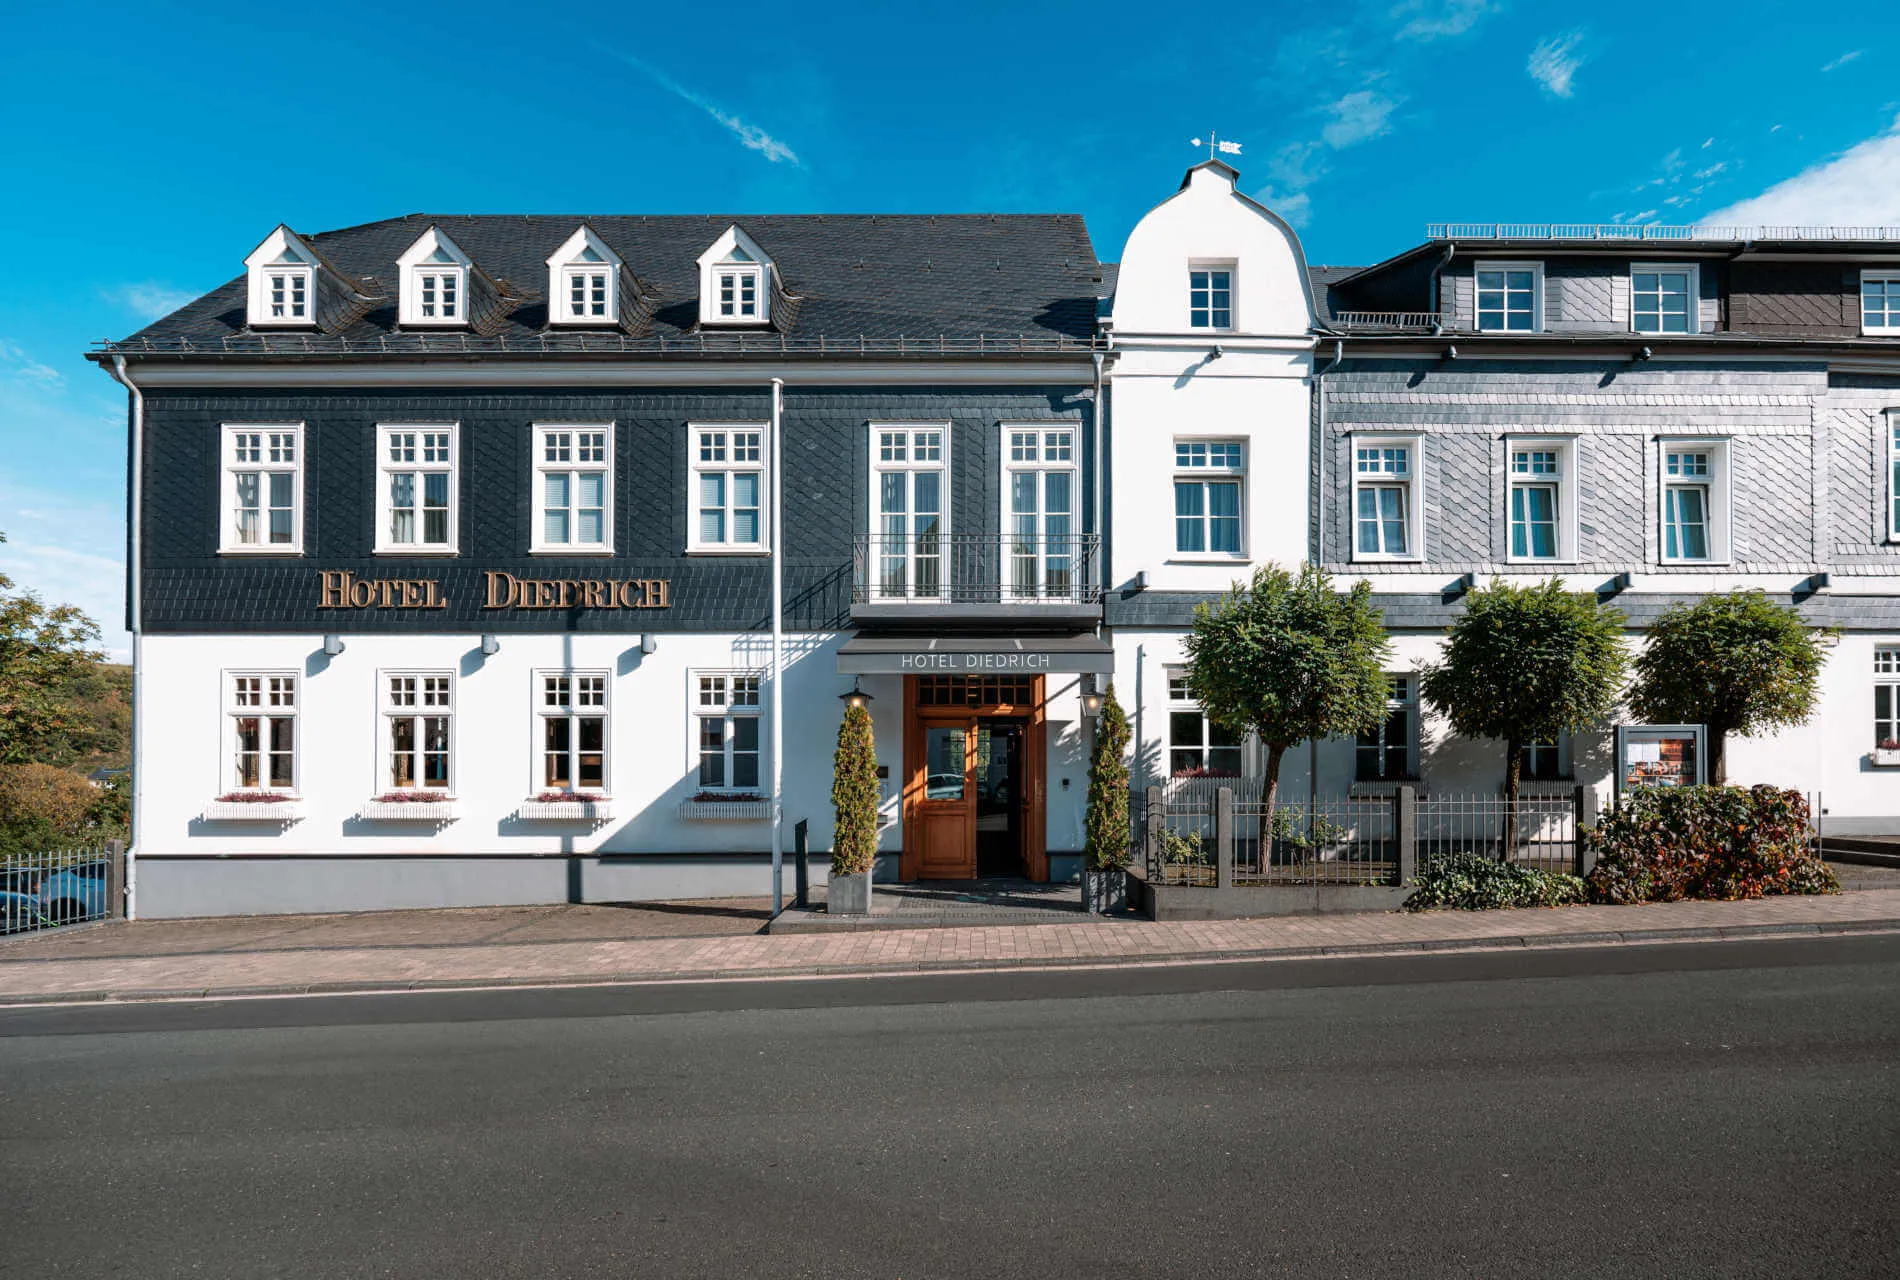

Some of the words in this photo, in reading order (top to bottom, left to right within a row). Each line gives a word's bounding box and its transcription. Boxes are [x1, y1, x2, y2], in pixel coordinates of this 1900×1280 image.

[318, 570, 447, 608] HOTEL
[483, 570, 672, 608] DIEDRICH
[901, 654, 957, 668] HOTEL
[966, 654, 1049, 668] DIEDRICH
